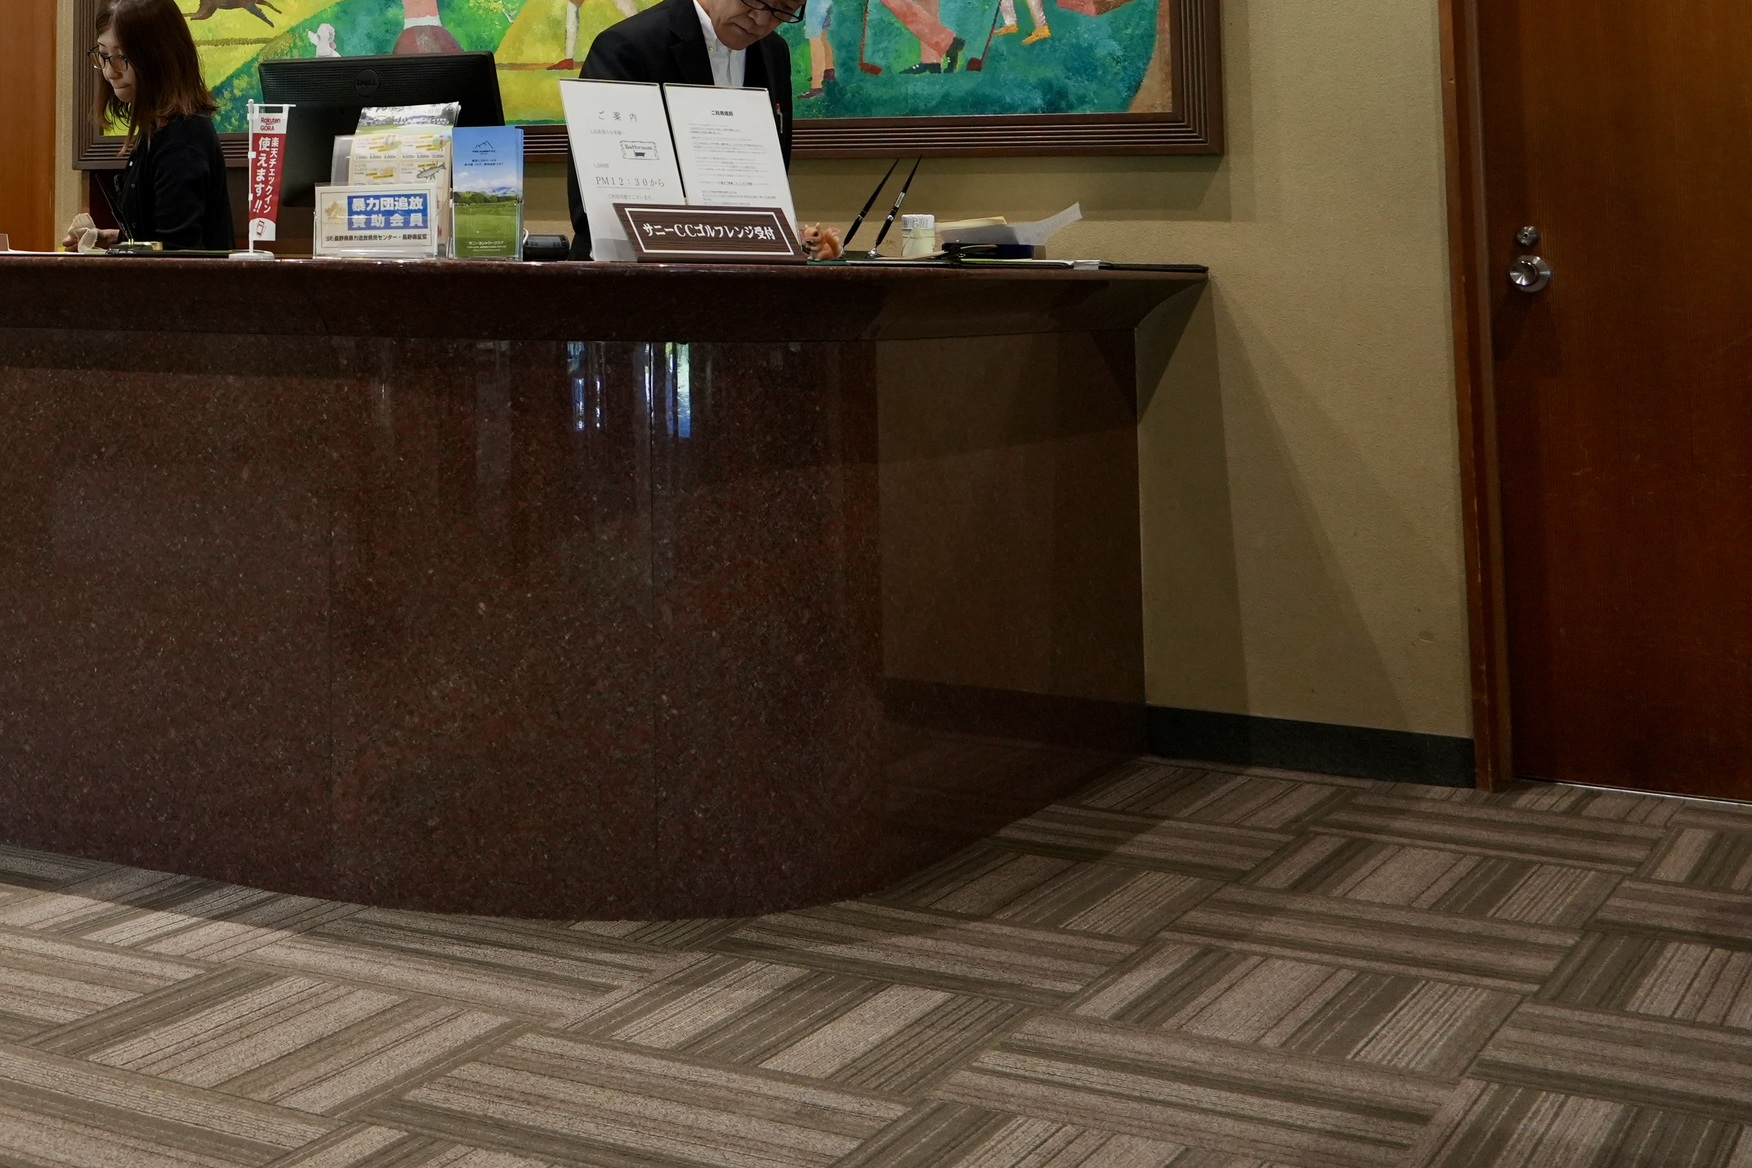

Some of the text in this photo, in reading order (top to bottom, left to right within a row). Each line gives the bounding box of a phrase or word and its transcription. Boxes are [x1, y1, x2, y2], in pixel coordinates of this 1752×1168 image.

[351, 196, 424, 212] 暴力団追放
[351, 212, 424, 228] 賛助会員
[642, 222, 776, 240] サニーCCゴルフレンジ受付
